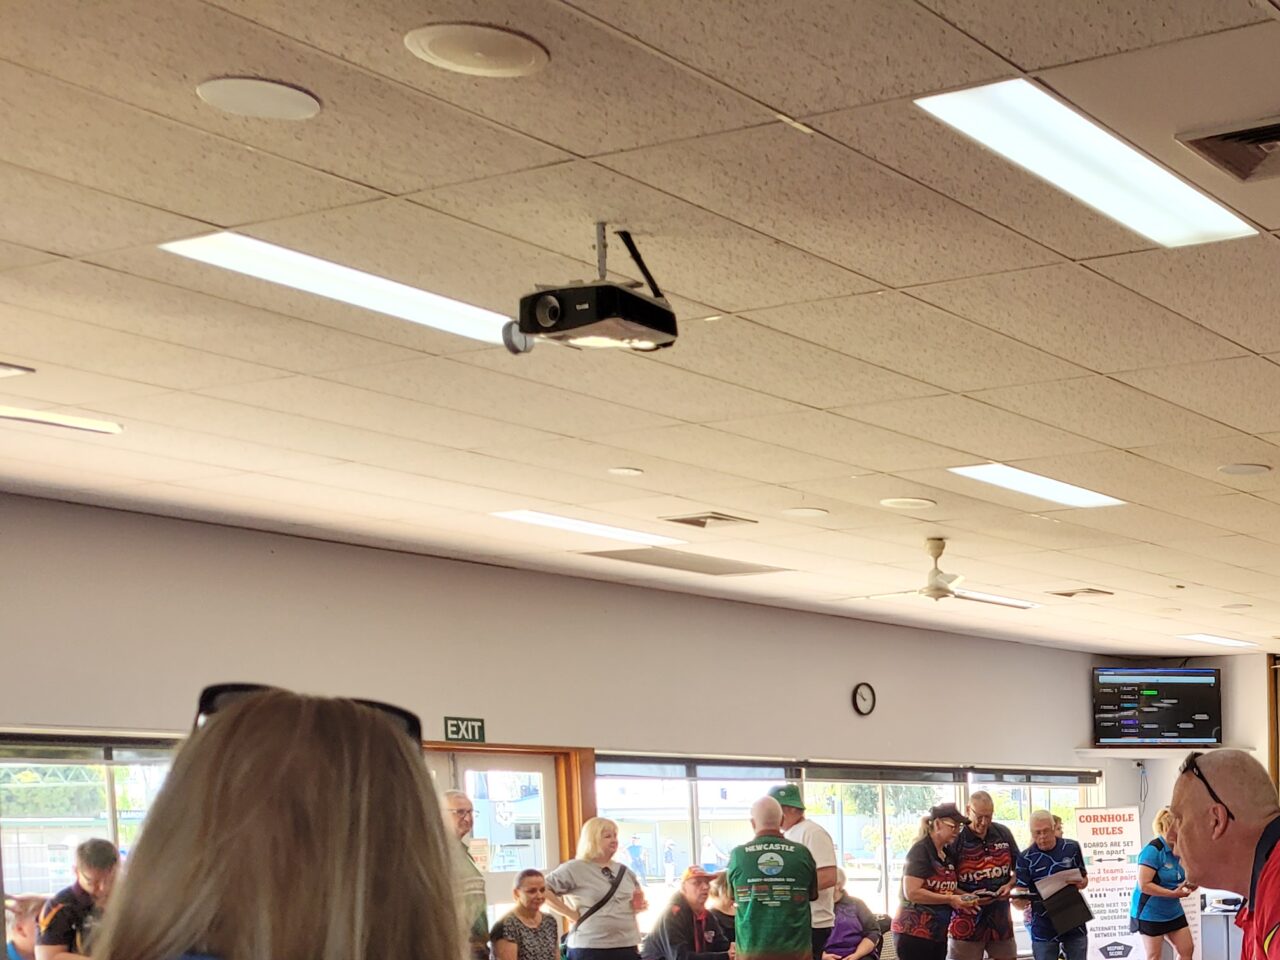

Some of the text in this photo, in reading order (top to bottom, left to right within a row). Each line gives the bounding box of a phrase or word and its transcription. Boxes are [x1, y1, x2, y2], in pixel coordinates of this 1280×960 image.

[447, 720, 482, 740] EXIT
[1079, 814, 1134, 823] CORNHOLE
[1092, 827, 1124, 836] RULES
[745, 843, 796, 853] NEWCASTLE
[1083, 841, 1108, 849] BOARDS
[1106, 848, 1125, 857] apart
[1088, 875, 1110, 883] ingles
[927, 879, 957, 890] VICTO
